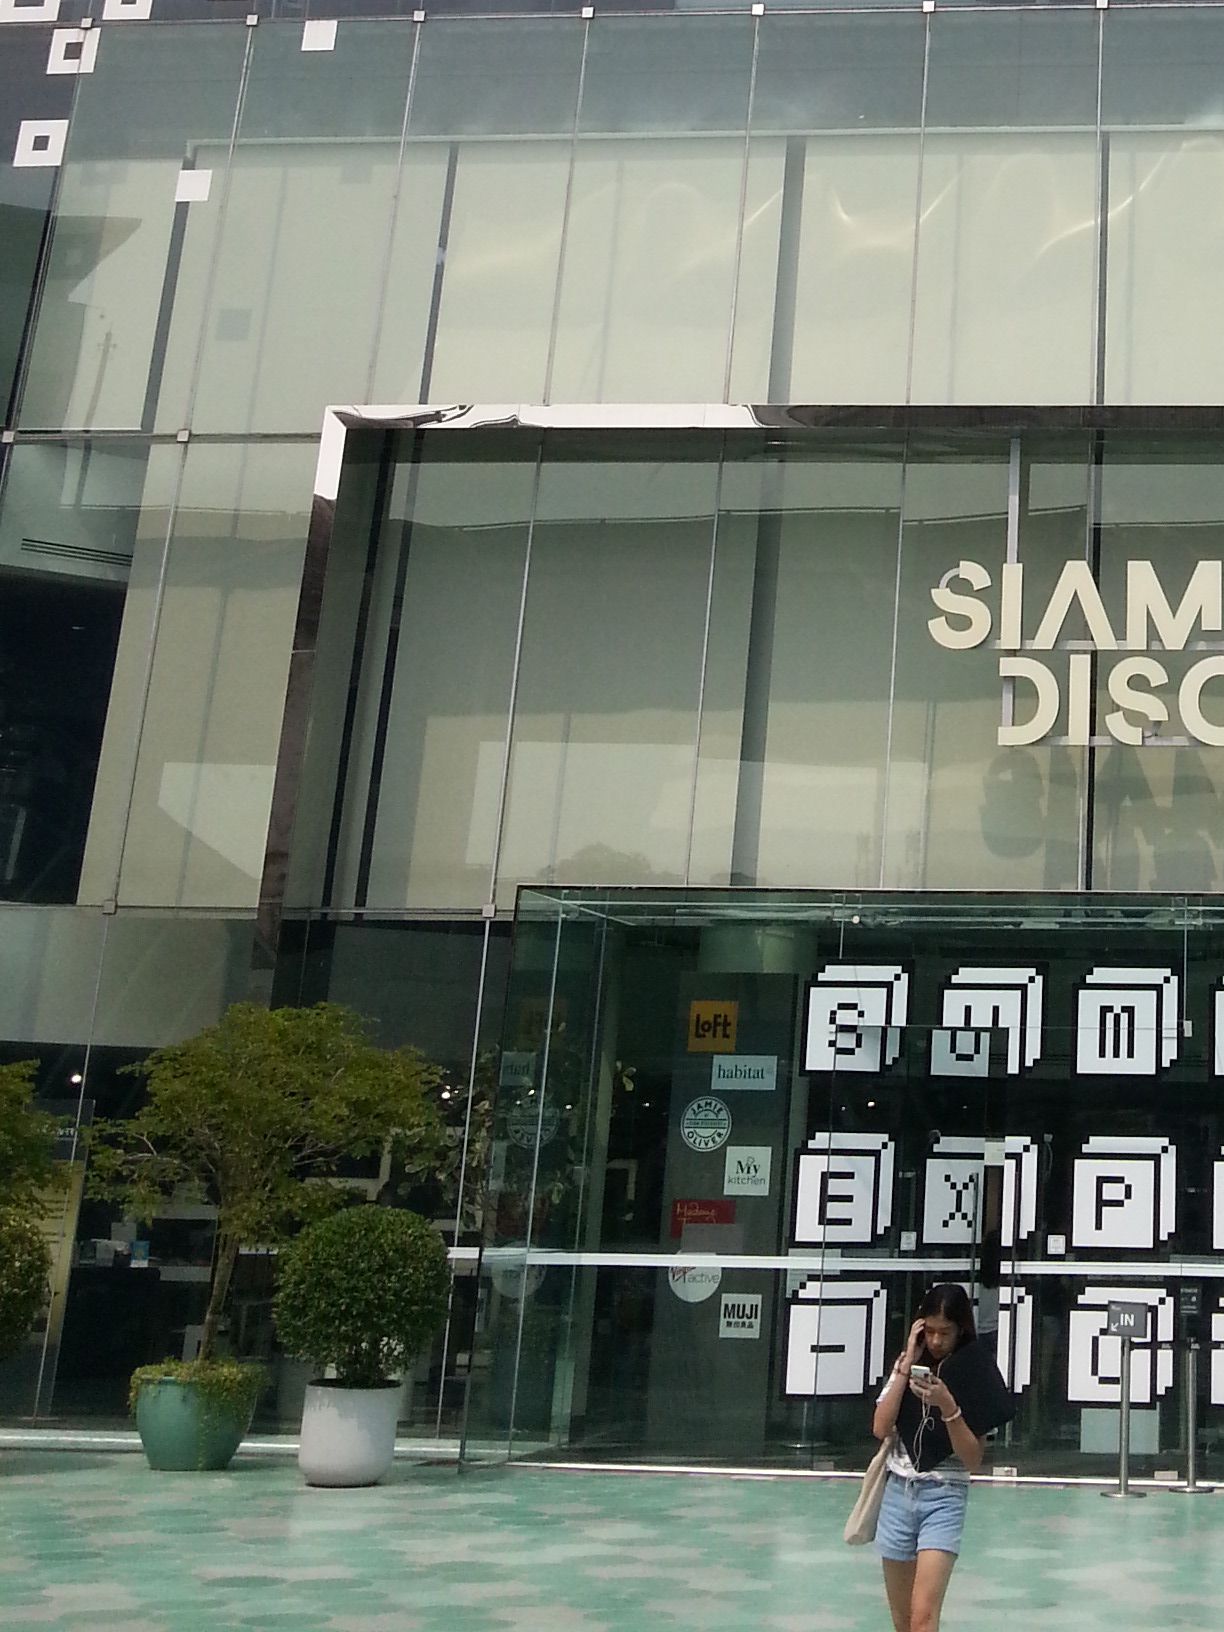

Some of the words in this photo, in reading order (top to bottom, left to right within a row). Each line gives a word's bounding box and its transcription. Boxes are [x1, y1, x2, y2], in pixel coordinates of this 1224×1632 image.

[927, 559, 1223, 651] SIAM
[717, 1063, 766, 1080] habitat
[690, 1101, 723, 1116] JAMIE
[687, 1130, 724, 1148] OLIVER
[735, 1159, 761, 1179] My
[727, 1174, 767, 1187] kitchen
[723, 1303, 759, 1320] MUJI
[1119, 1313, 1135, 1327] IN
